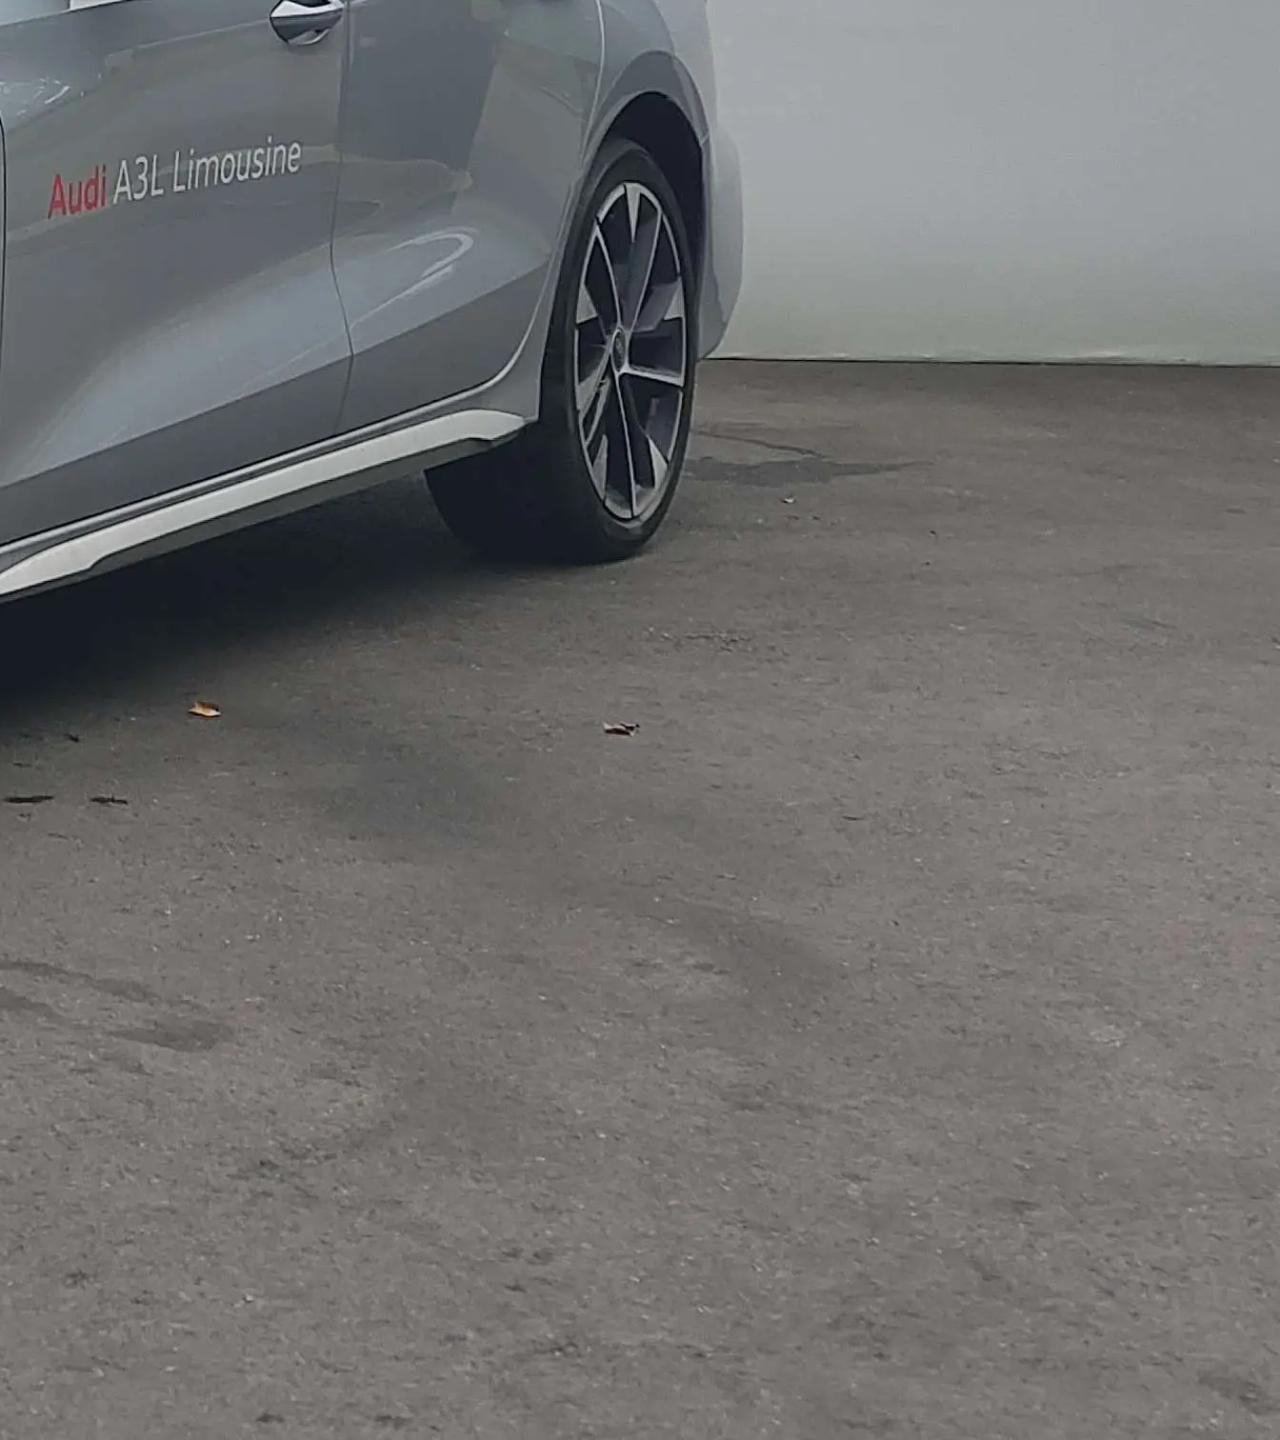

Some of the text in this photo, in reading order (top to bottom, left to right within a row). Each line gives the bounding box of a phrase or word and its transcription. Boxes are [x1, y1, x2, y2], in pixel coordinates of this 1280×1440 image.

[47, 136, 302, 219] Audi A3L Limousine
